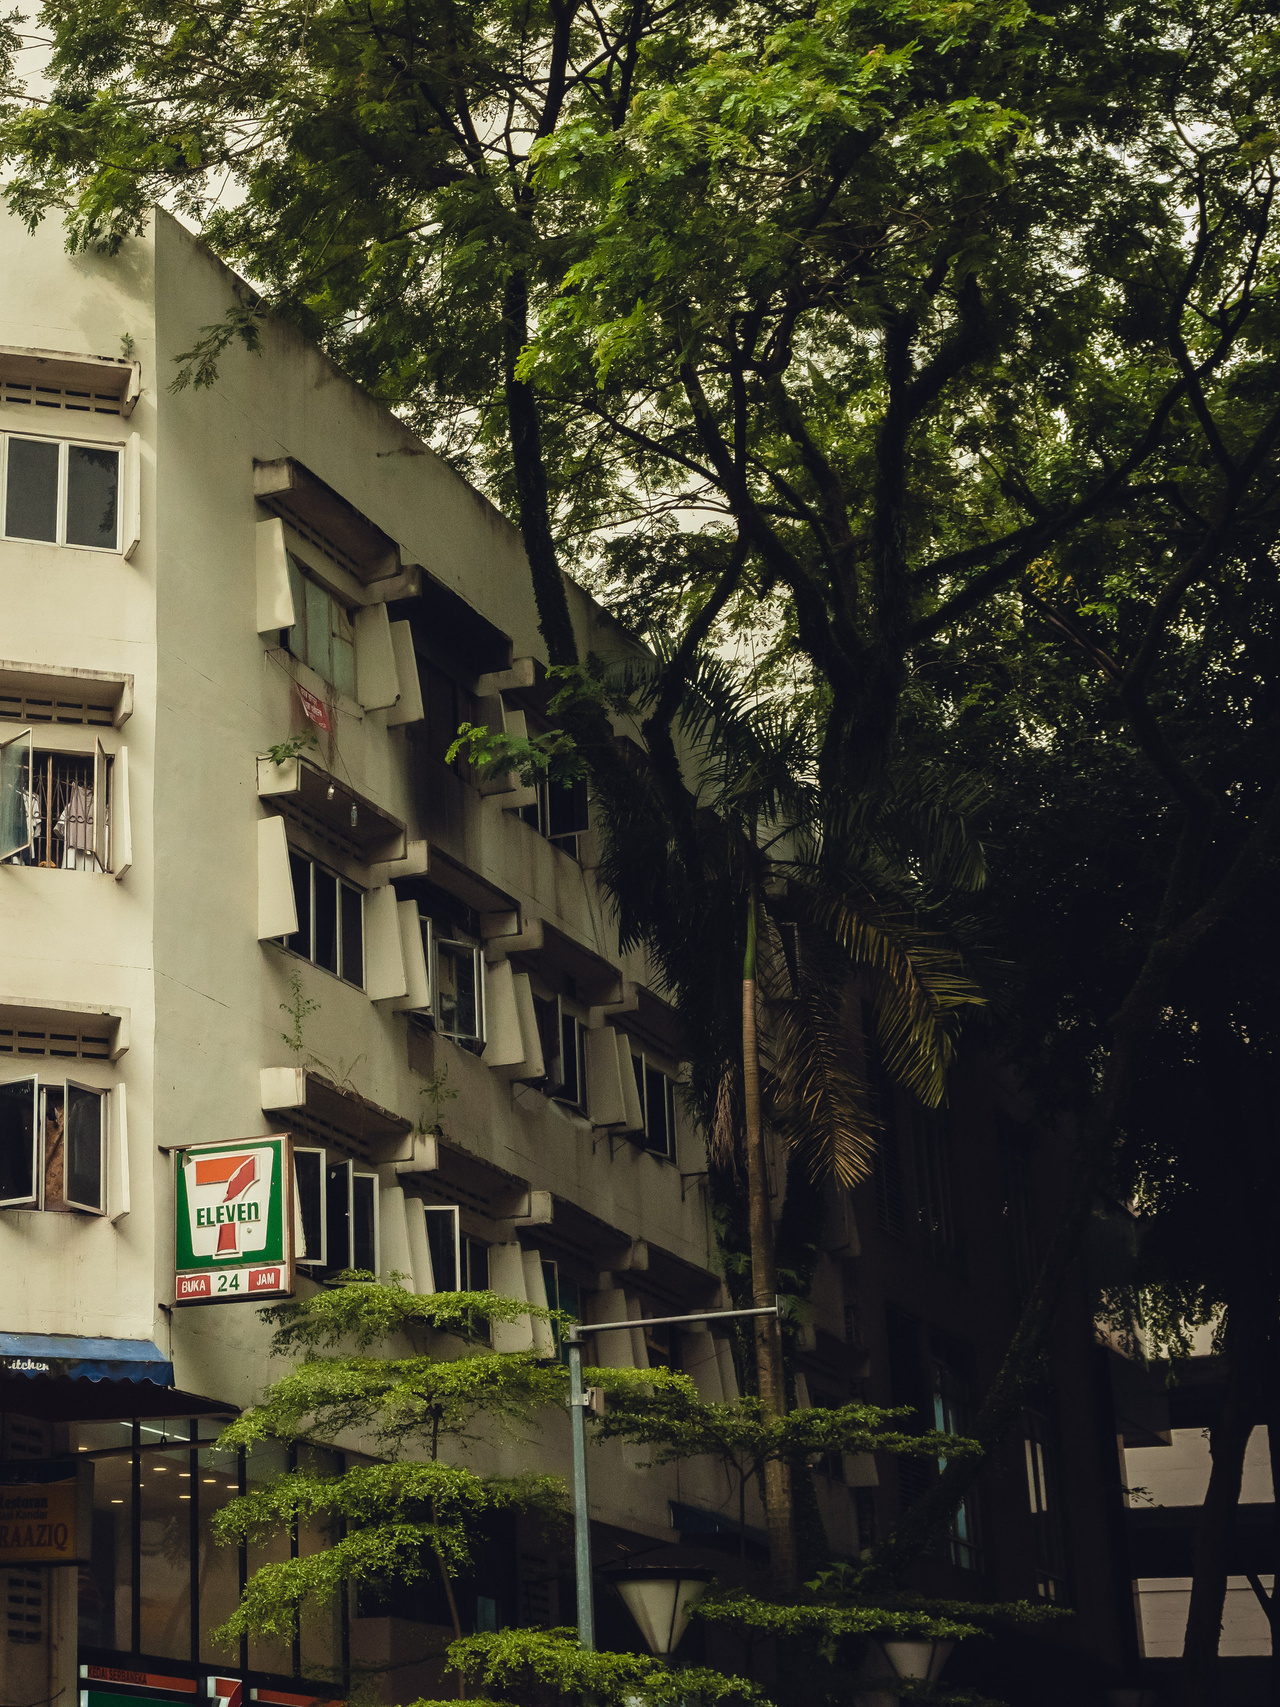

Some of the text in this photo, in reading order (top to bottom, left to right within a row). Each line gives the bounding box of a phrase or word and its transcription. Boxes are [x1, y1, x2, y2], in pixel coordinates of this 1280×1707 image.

[181, 1272, 275, 1293] BUKA 24 JAM
[15, 1510, 48, 1520] Kandar
[88, 1665, 108, 1679] KEDAI
